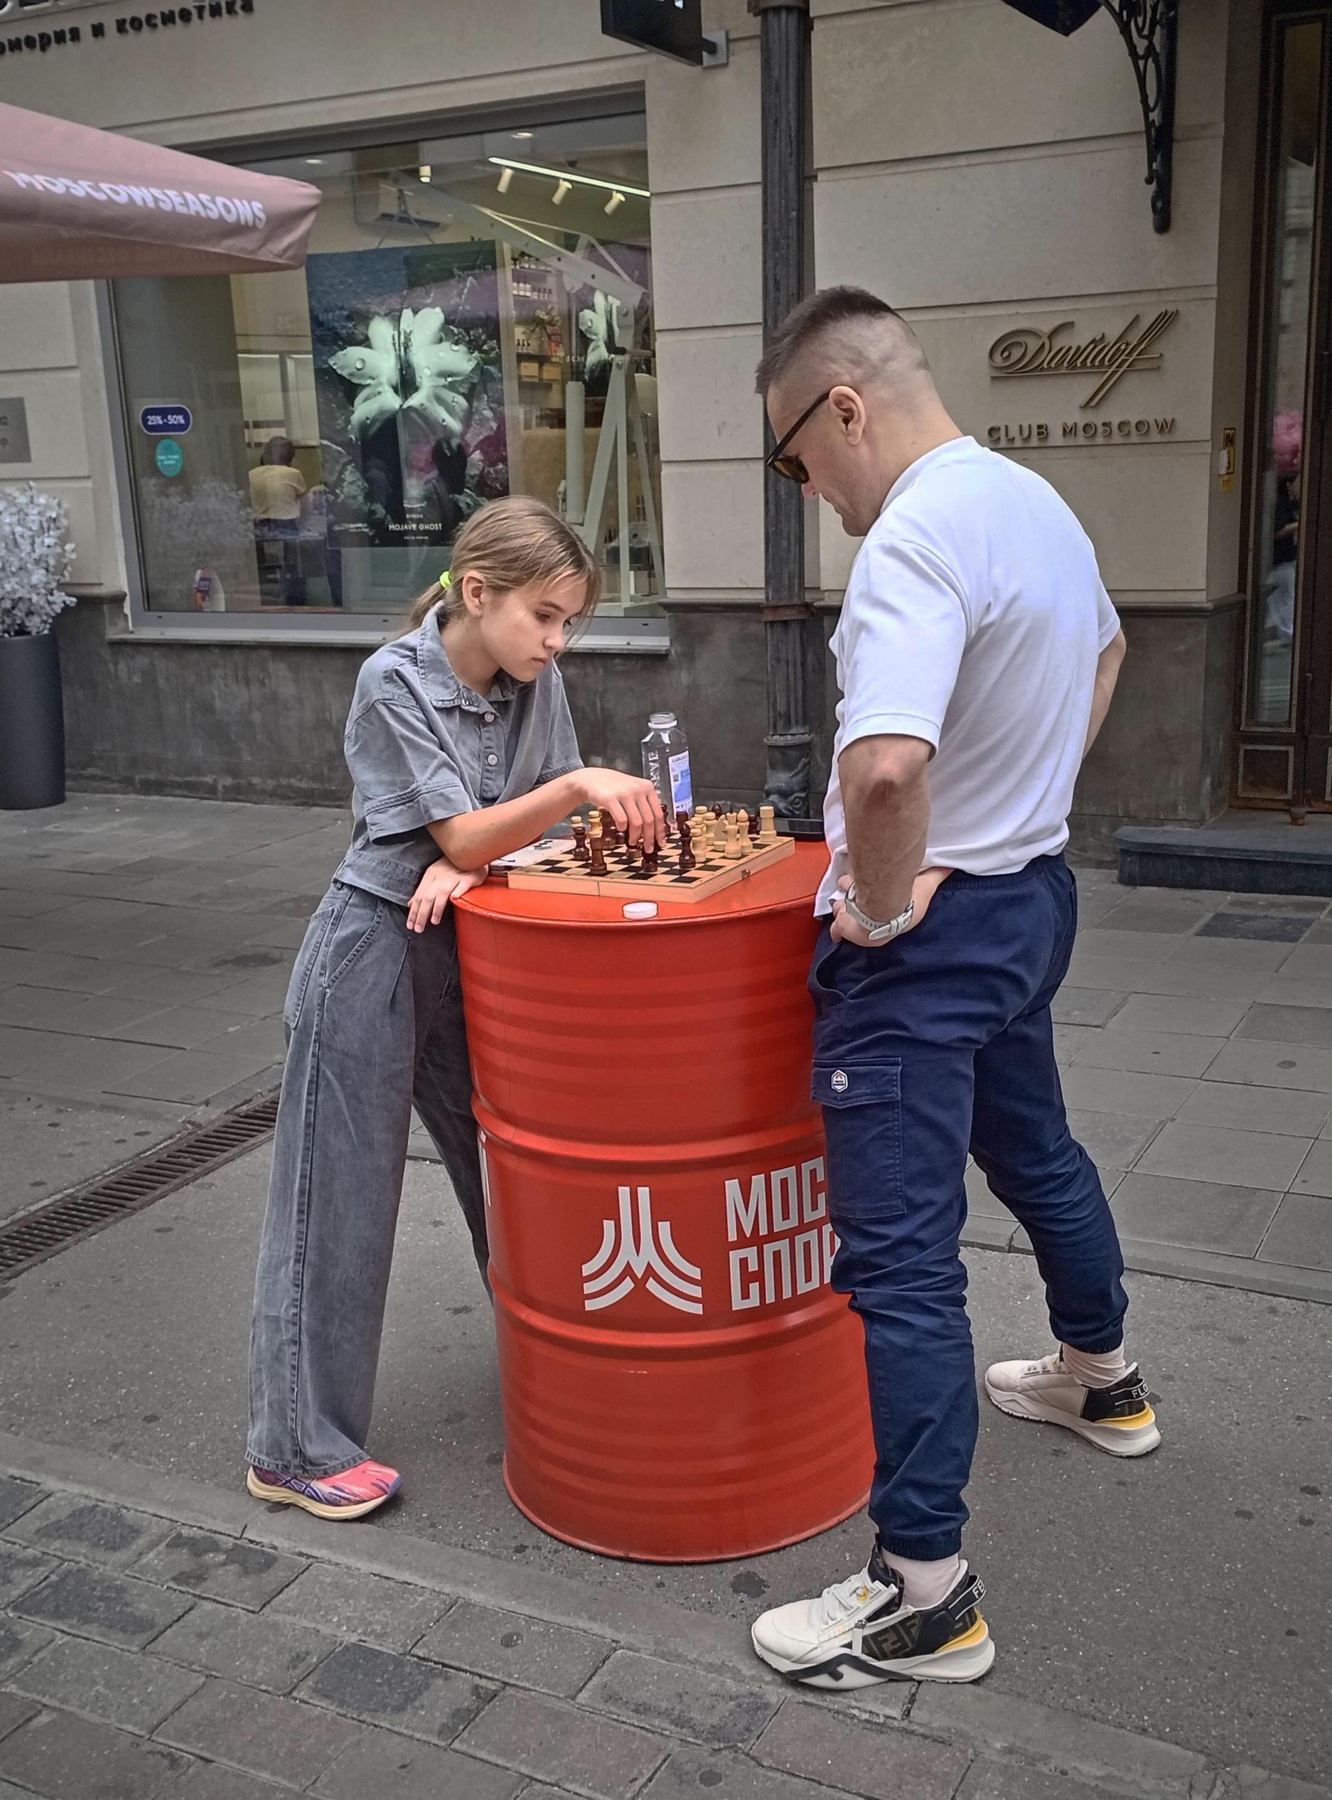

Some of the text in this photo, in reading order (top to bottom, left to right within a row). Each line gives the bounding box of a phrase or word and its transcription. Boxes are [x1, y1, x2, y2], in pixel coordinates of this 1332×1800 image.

[91, 22, 105, 38] и
[3, 170, 267, 228] MOSCOWSEASONS
[988, 308, 1179, 409] Davidoff
[987, 417, 1176, 442] CLUB MOSCOW
